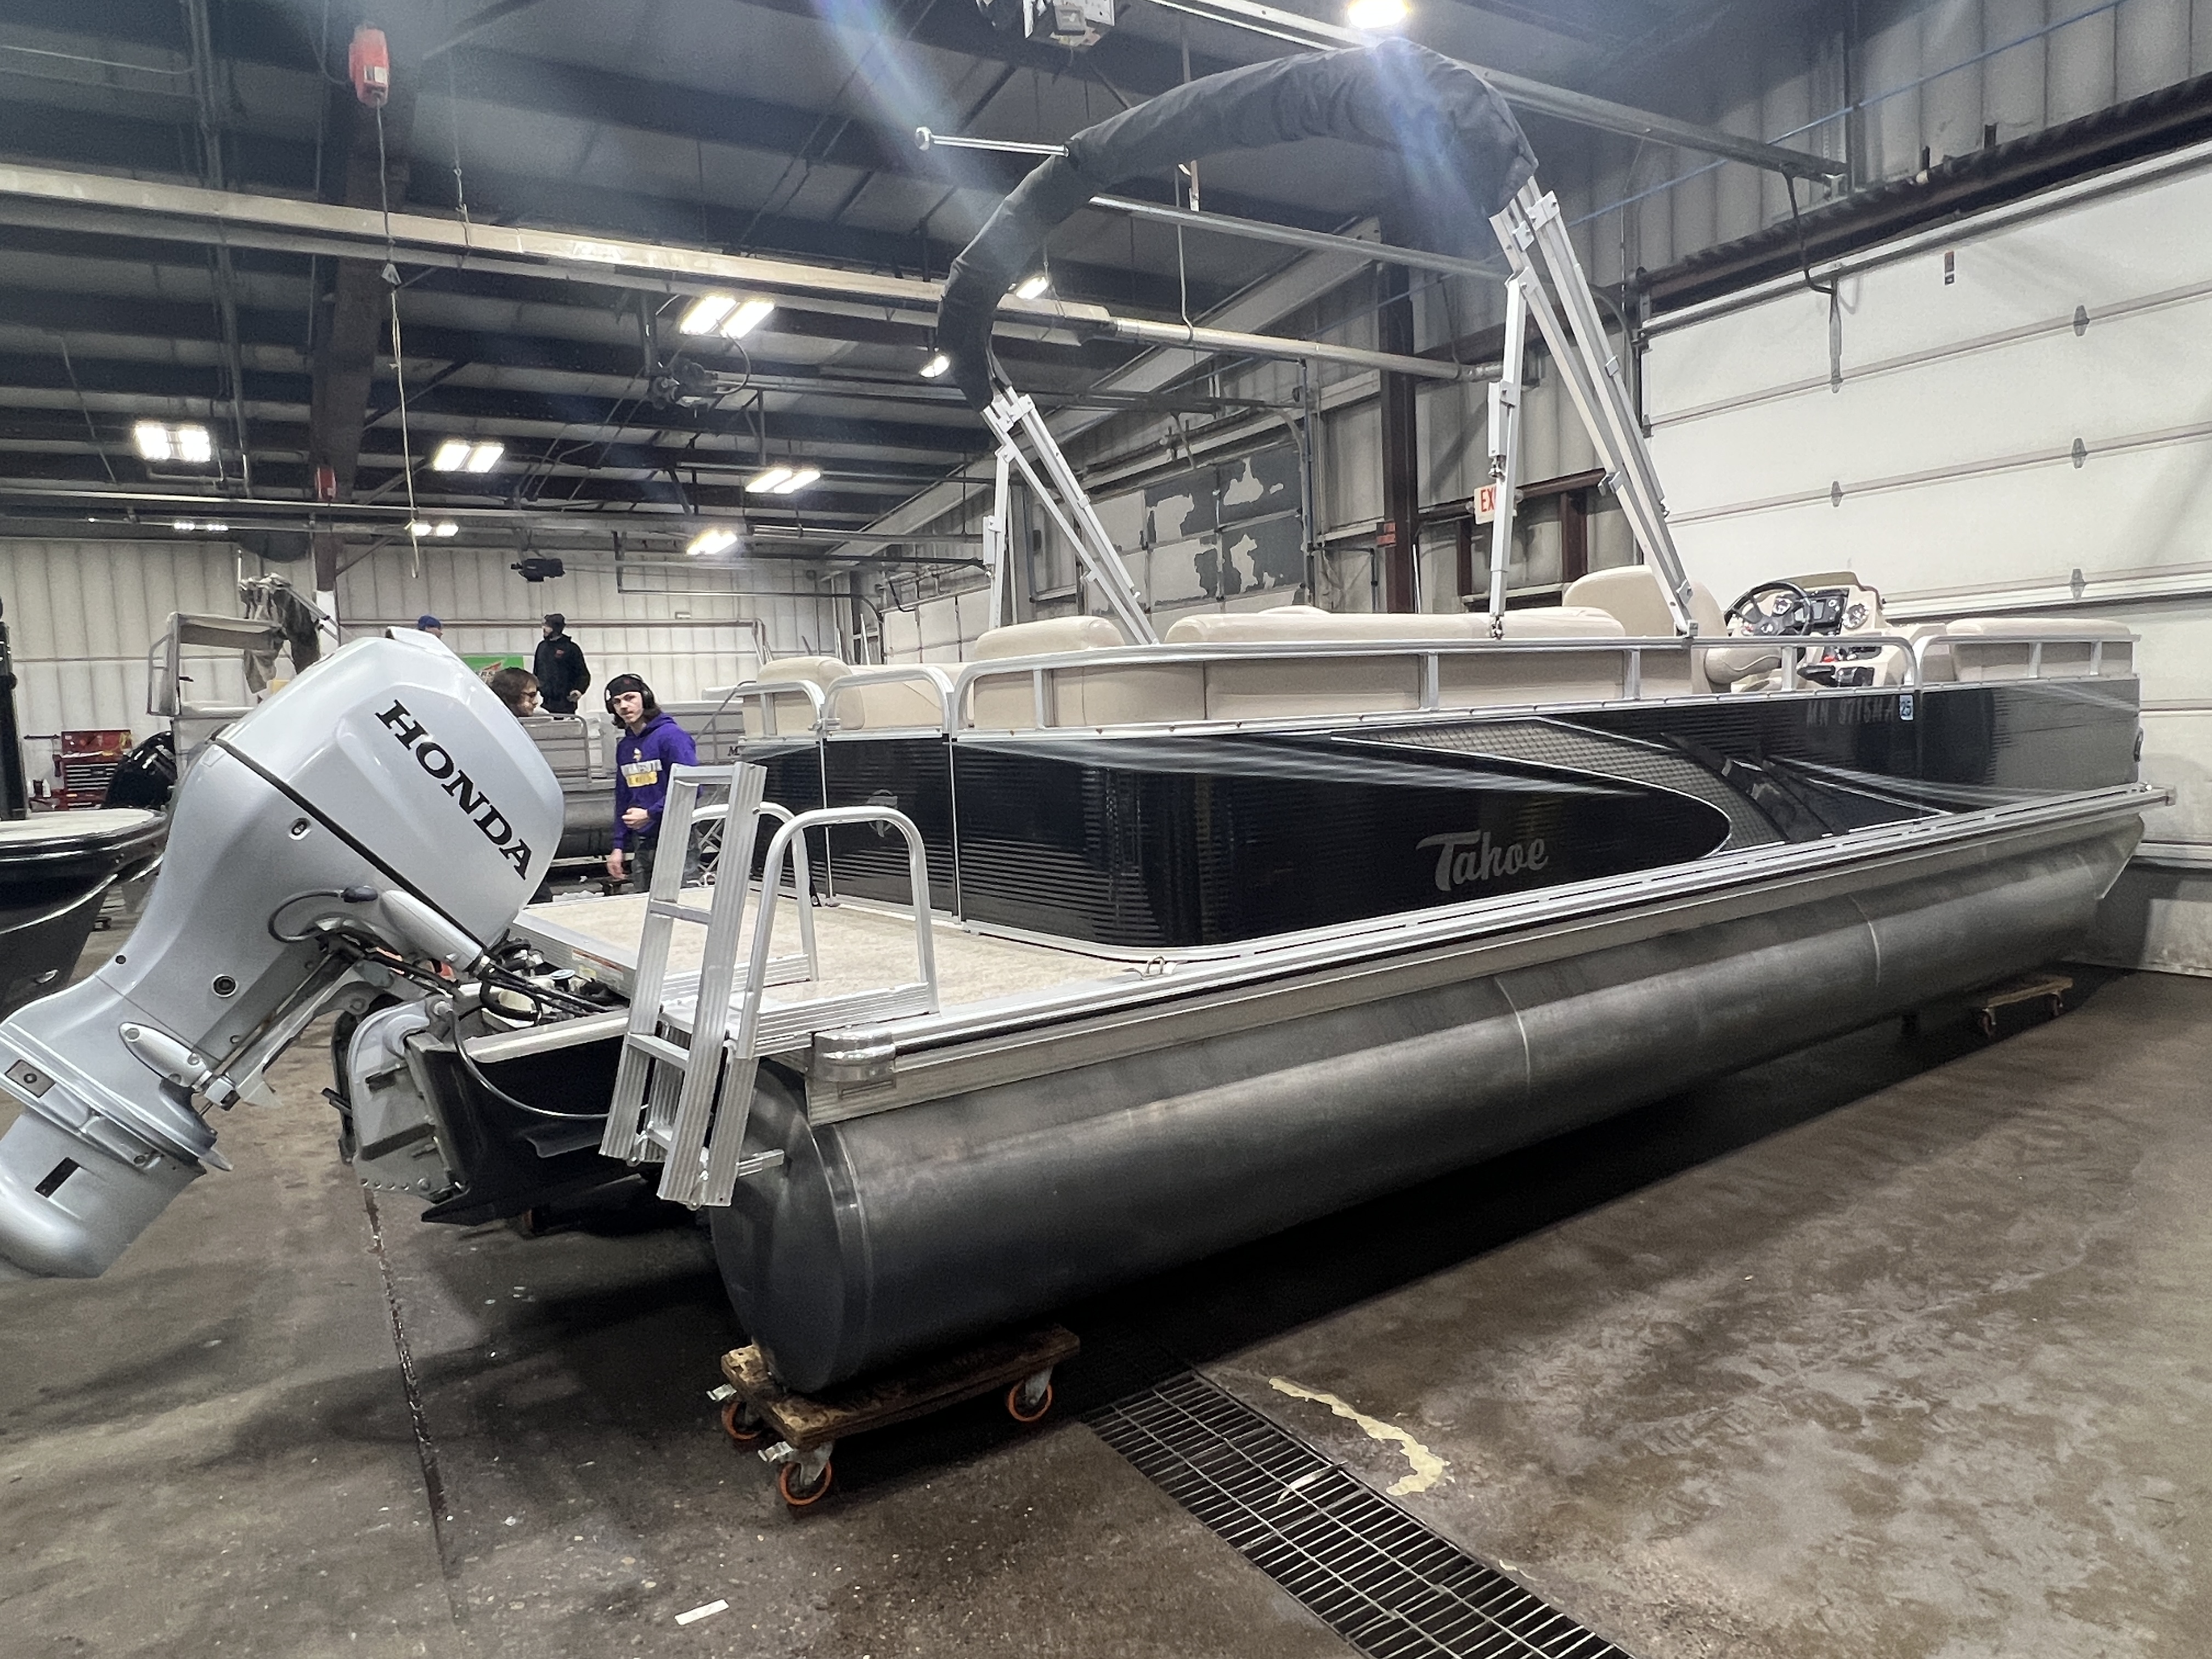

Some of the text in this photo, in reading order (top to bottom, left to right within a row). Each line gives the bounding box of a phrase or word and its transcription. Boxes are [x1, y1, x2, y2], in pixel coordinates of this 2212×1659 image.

[1481, 488, 1494, 512] EX
[1900, 699, 1911, 716] 25
[375, 699, 532, 881] HONDA
[1415, 829, 1549, 891] Tahoe
